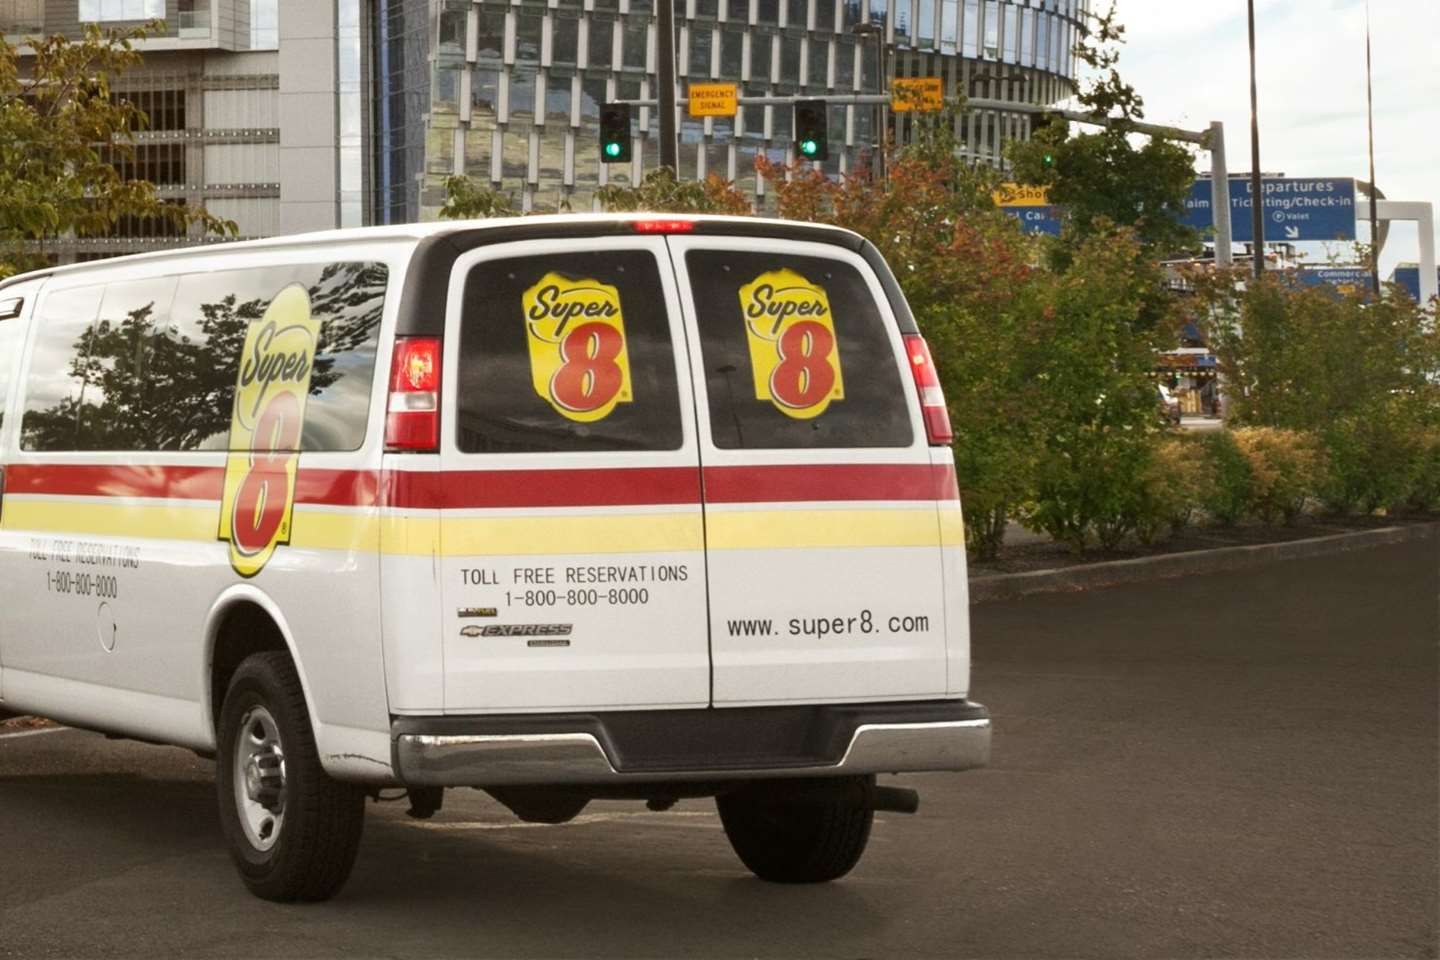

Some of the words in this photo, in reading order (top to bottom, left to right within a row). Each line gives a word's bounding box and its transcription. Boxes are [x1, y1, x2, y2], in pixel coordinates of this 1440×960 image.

[1231, 196, 1352, 209] Ticting/Check-in
[529, 285, 618, 337] Super
[747, 284, 828, 335] Super
[241, 321, 310, 418] Super
[550, 321, 624, 411] 8
[769, 320, 836, 409] 8
[232, 390, 302, 557] 8
[47, 570, 118, 599] 1-800-800-8000
[460, 568, 500, 585] TOLL
[513, 567, 556, 584] FREE
[566, 565, 688, 583] RESERVATIONS
[505, 588, 649, 607] 1-800-800-8000
[482, 624, 573, 636] EXPRESS
